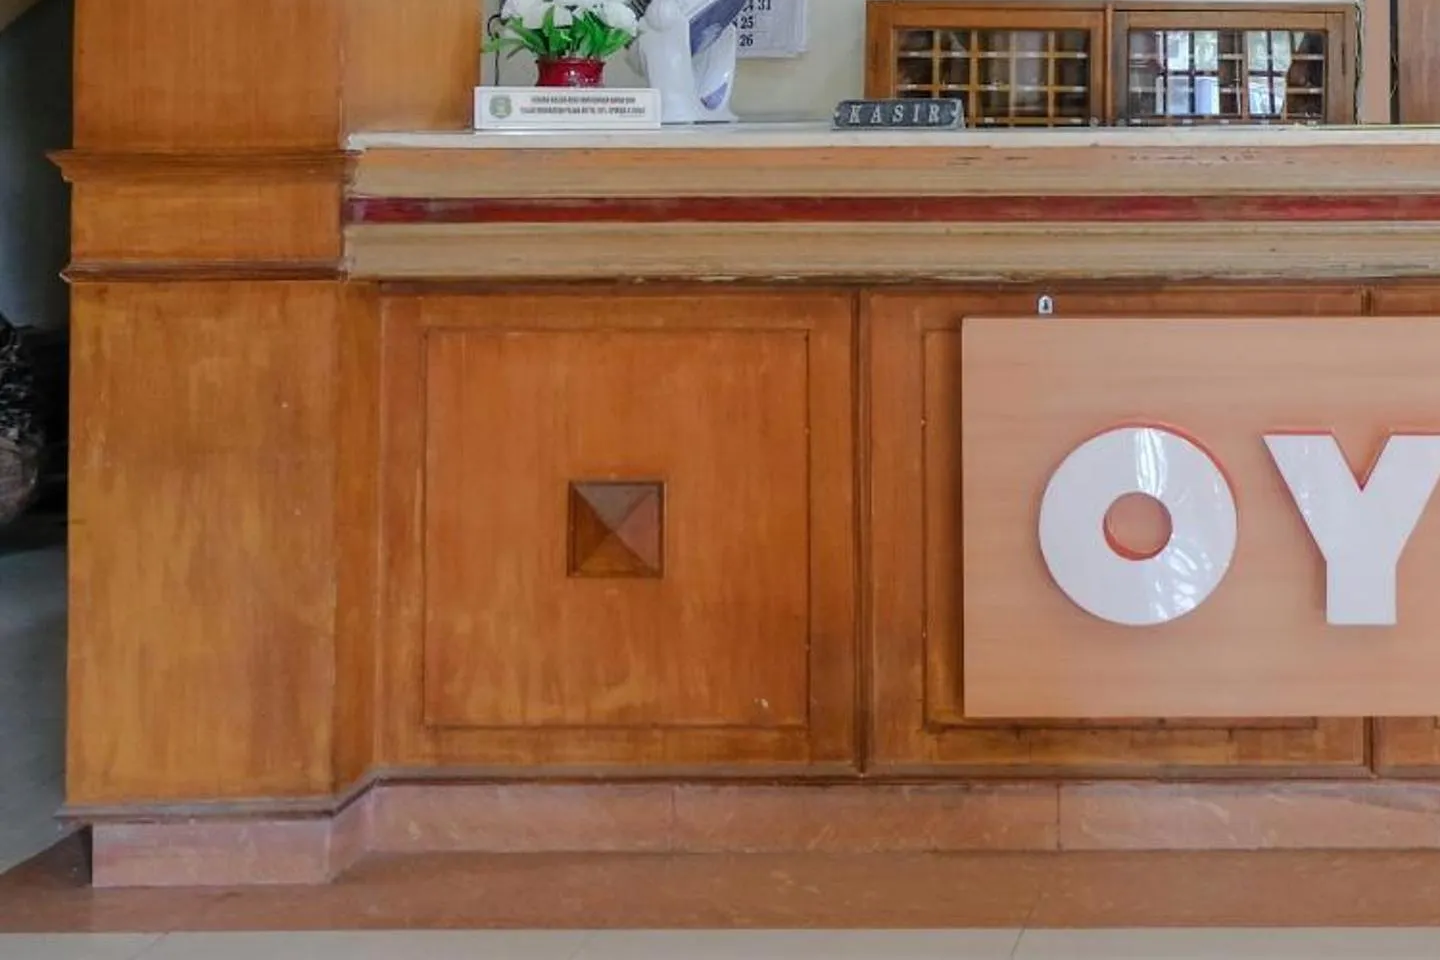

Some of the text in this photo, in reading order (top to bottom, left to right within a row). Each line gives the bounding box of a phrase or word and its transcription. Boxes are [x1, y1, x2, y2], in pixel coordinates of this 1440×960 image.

[740, 16, 754, 29] 25
[739, 34, 754, 47] 26
[848, 104, 940, 123] KASIR
